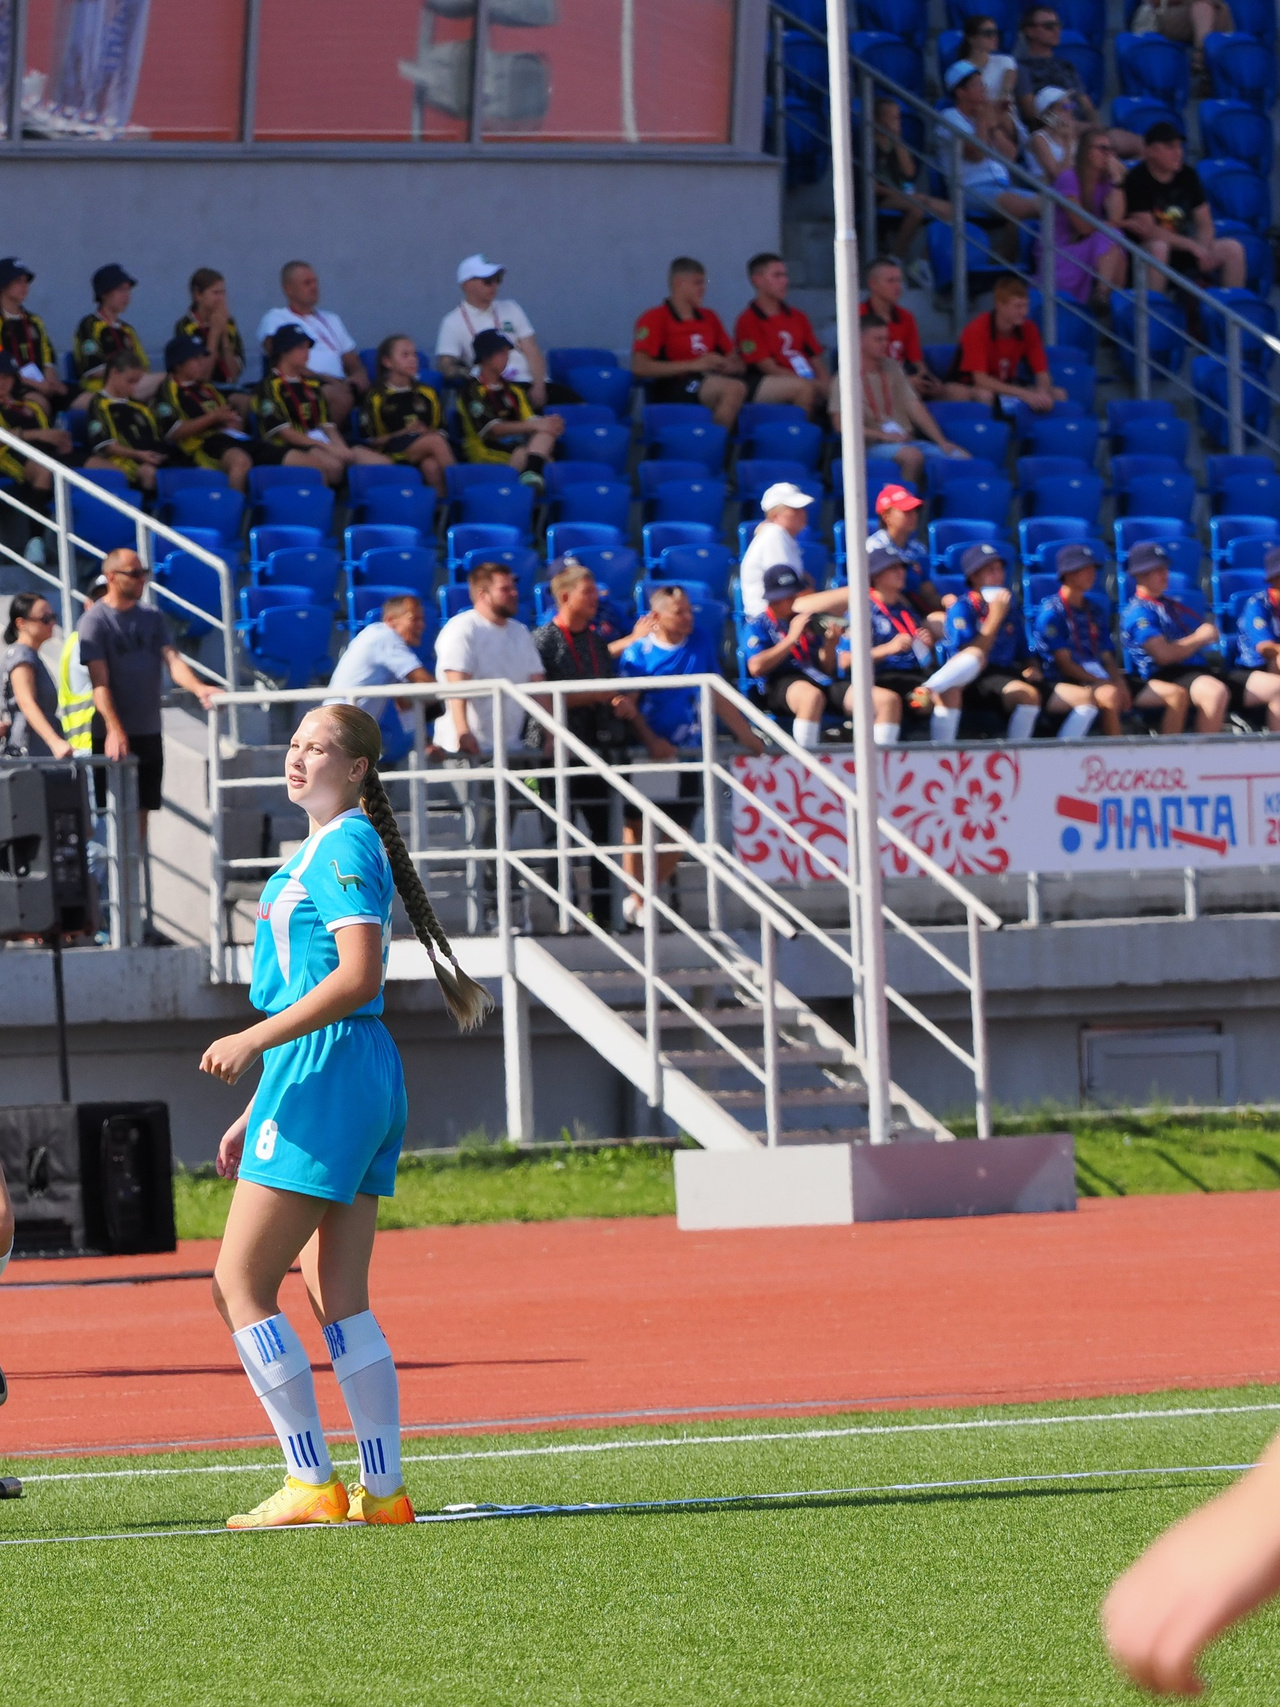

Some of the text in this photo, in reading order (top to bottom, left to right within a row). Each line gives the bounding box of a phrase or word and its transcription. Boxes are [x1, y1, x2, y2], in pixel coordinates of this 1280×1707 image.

[1077, 754, 1188, 793] Русская
[1095, 794, 1237, 850] ЛАПТА
[255, 1118, 278, 1160] 8
